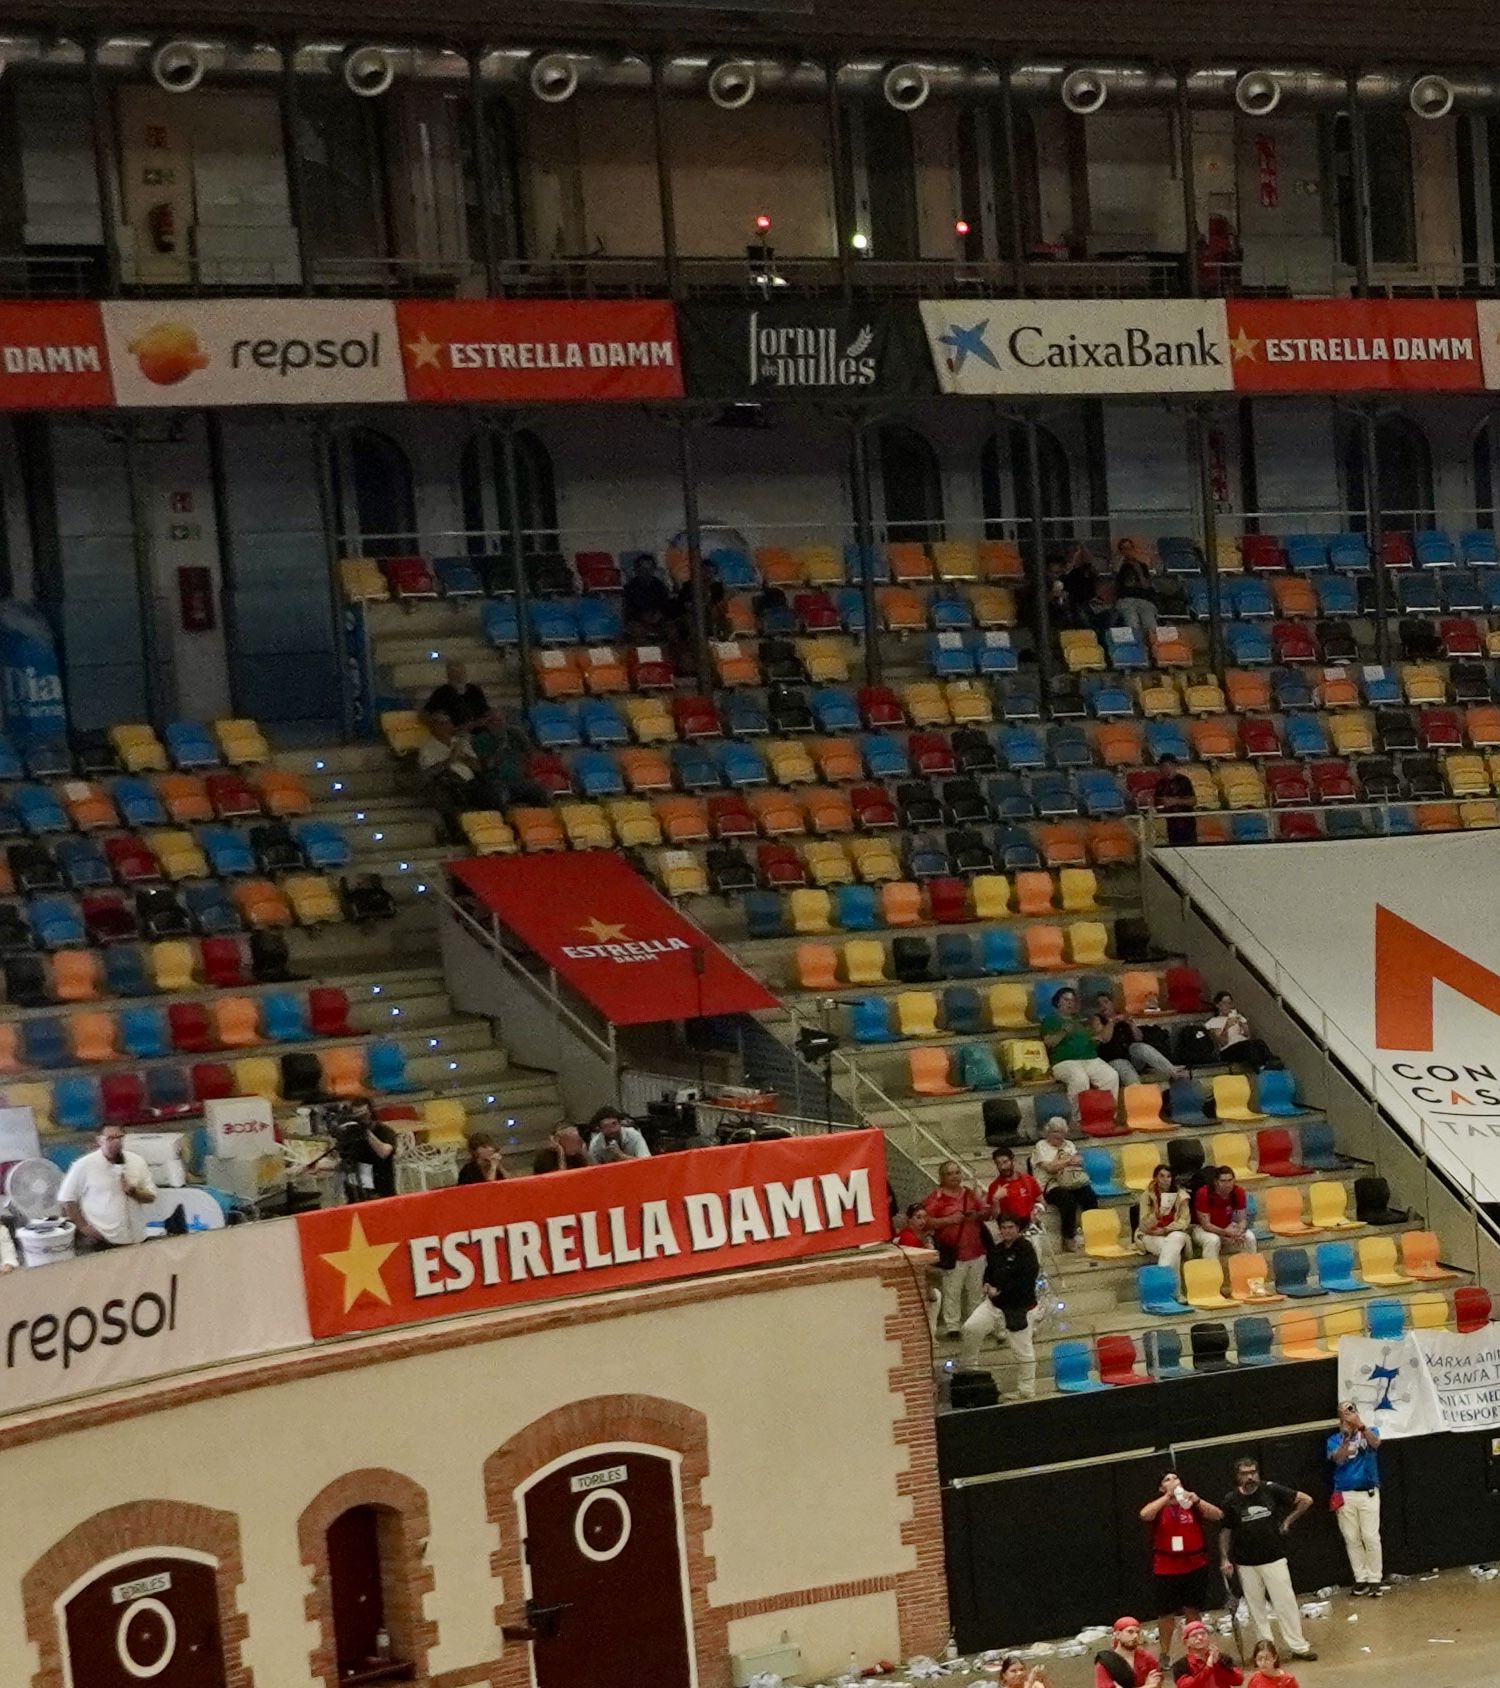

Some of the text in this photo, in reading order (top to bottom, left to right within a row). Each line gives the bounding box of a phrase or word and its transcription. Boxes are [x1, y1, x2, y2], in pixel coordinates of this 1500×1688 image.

[4, 344, 101, 374] DAMM
[231, 332, 380, 377] repsol
[450, 339, 674, 371] ESTRELLA DAMM
[1008, 326, 1224, 372] CaixaBank
[1266, 337, 1474, 362] ESTRELLA DAMM
[560, 937, 691, 959] ESTRELLA
[408, 1168, 876, 1299] ESTRELLA DAMM
[7, 1273, 178, 1370] repsol
[1425, 1352, 1471, 1369] XARXA
[1444, 1368, 1491, 1386] SANTA
